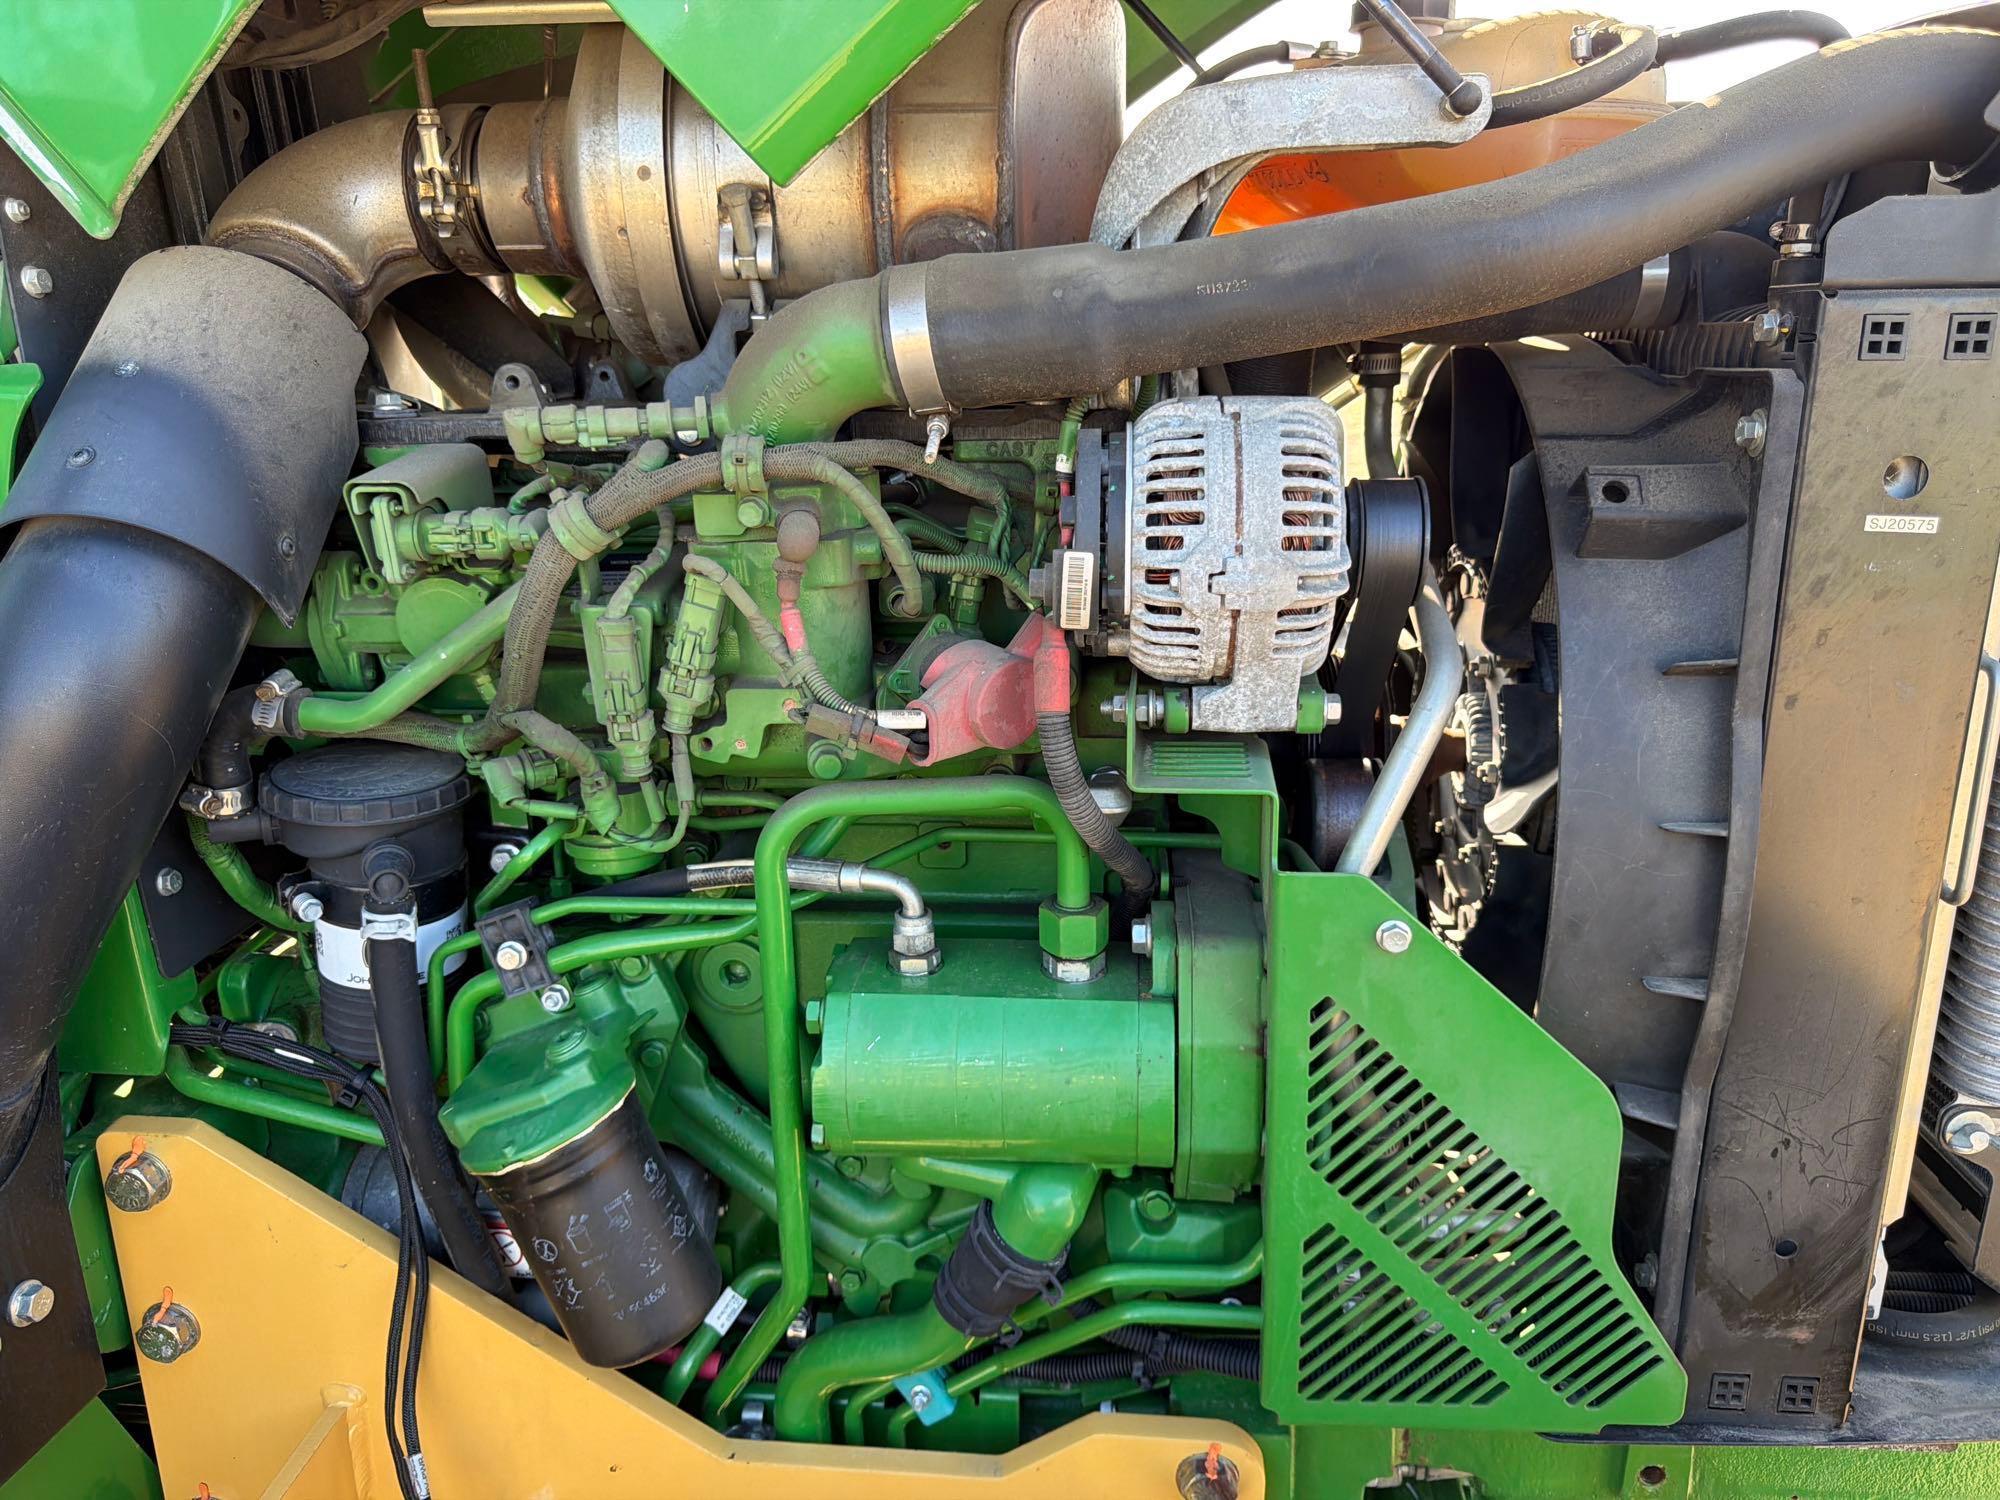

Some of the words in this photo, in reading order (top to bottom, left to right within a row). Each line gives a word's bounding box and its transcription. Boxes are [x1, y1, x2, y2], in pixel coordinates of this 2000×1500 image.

[985, 440, 1036, 457] CAST
[1869, 517, 1935, 531] SJ20575
[346, 972, 371, 984] JOH
[1867, 1322, 1887, 1335] ISO
